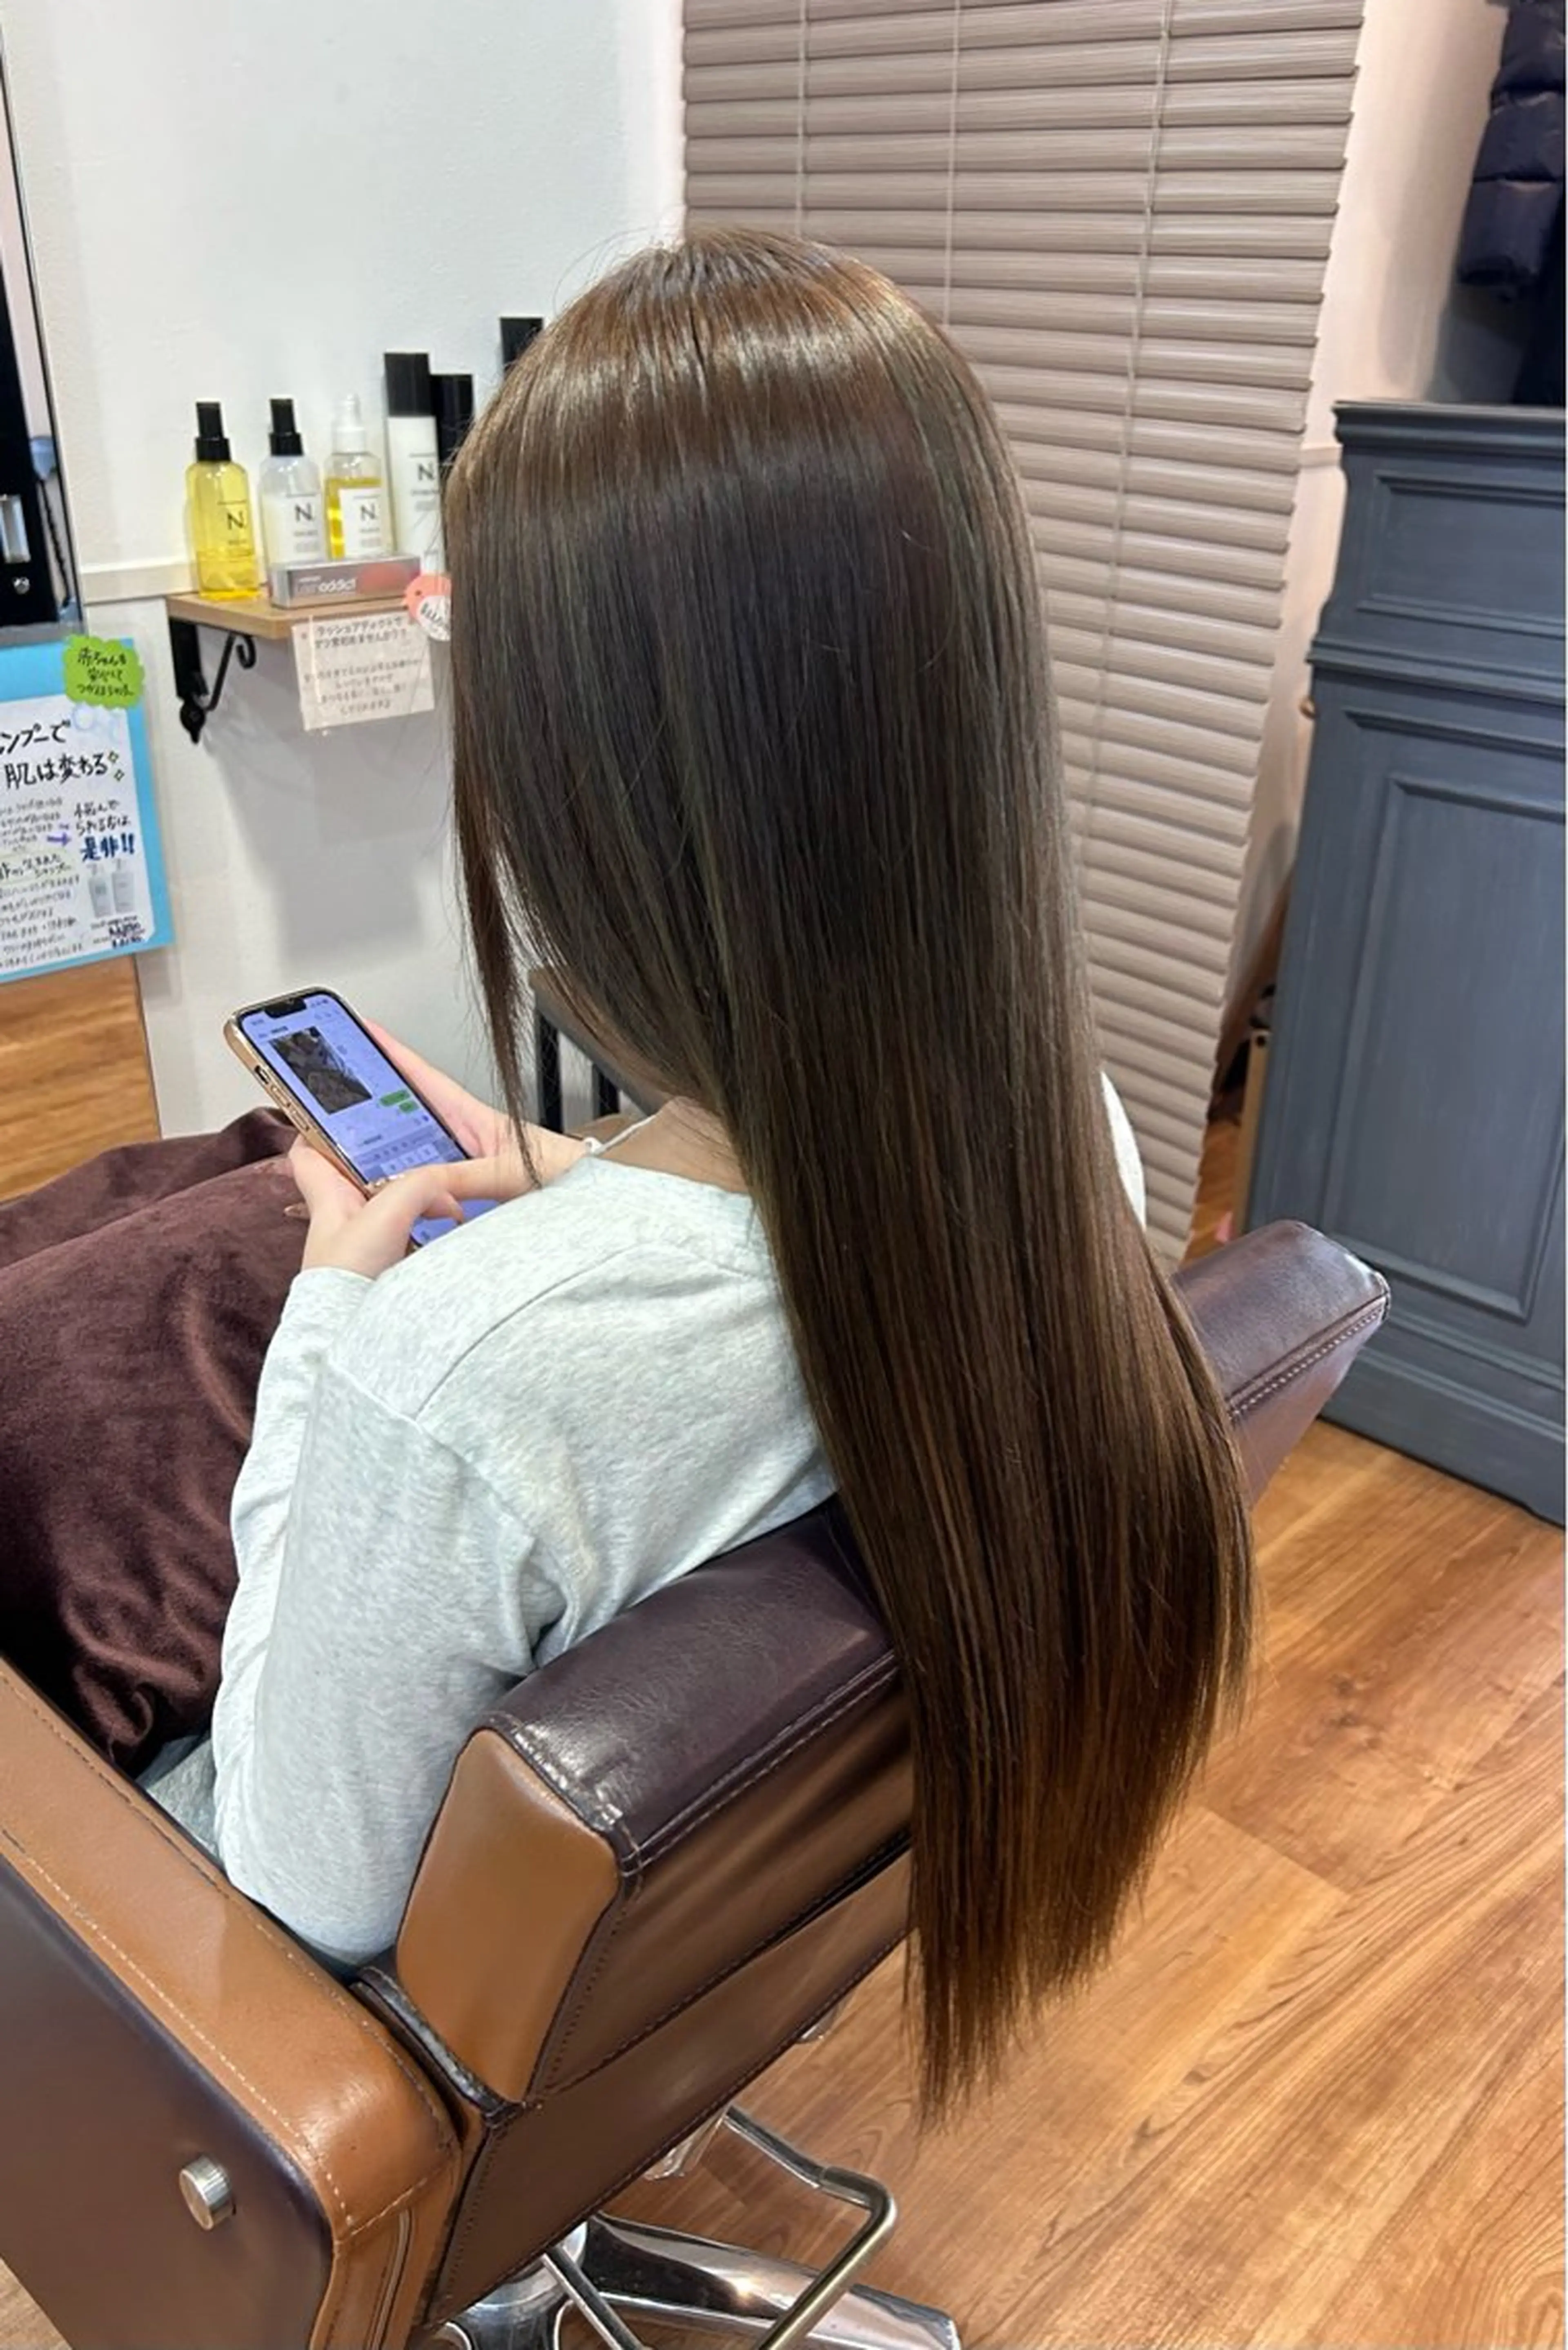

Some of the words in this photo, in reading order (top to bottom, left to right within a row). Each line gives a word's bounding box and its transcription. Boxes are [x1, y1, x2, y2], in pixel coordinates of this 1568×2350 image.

[227, 510, 244, 530] N
[294, 503, 313, 521] N
[360, 504, 376, 521] N
[0, 719, 71, 755] ンプーで
[4, 753, 108, 789] 肌は変わる
